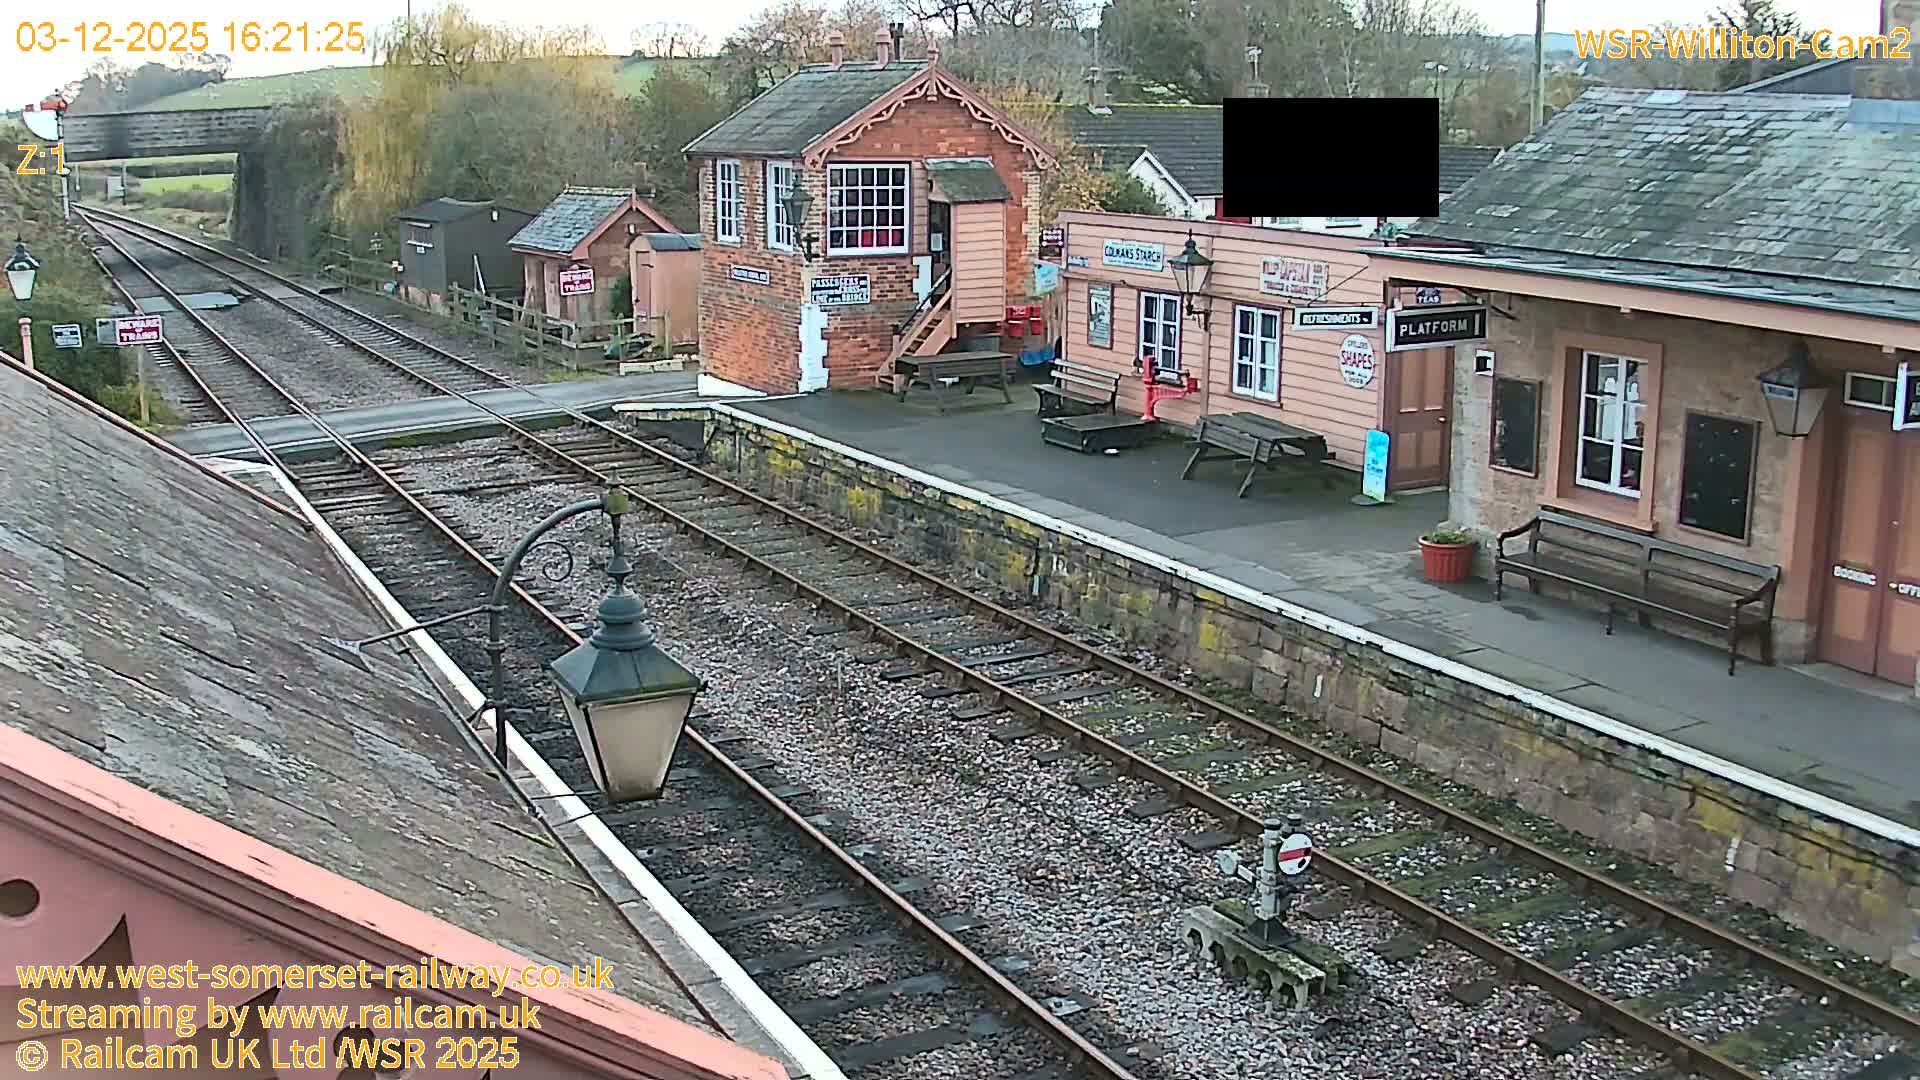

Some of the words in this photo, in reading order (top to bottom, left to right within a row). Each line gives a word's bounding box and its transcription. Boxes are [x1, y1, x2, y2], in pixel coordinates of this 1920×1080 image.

[1417, 295, 1440, 303] TEAS
[1302, 313, 1361, 325] REFRESHMENTS
[1399, 318, 1468, 337] PLATFORM
[1341, 350, 1372, 370] SHAPES
